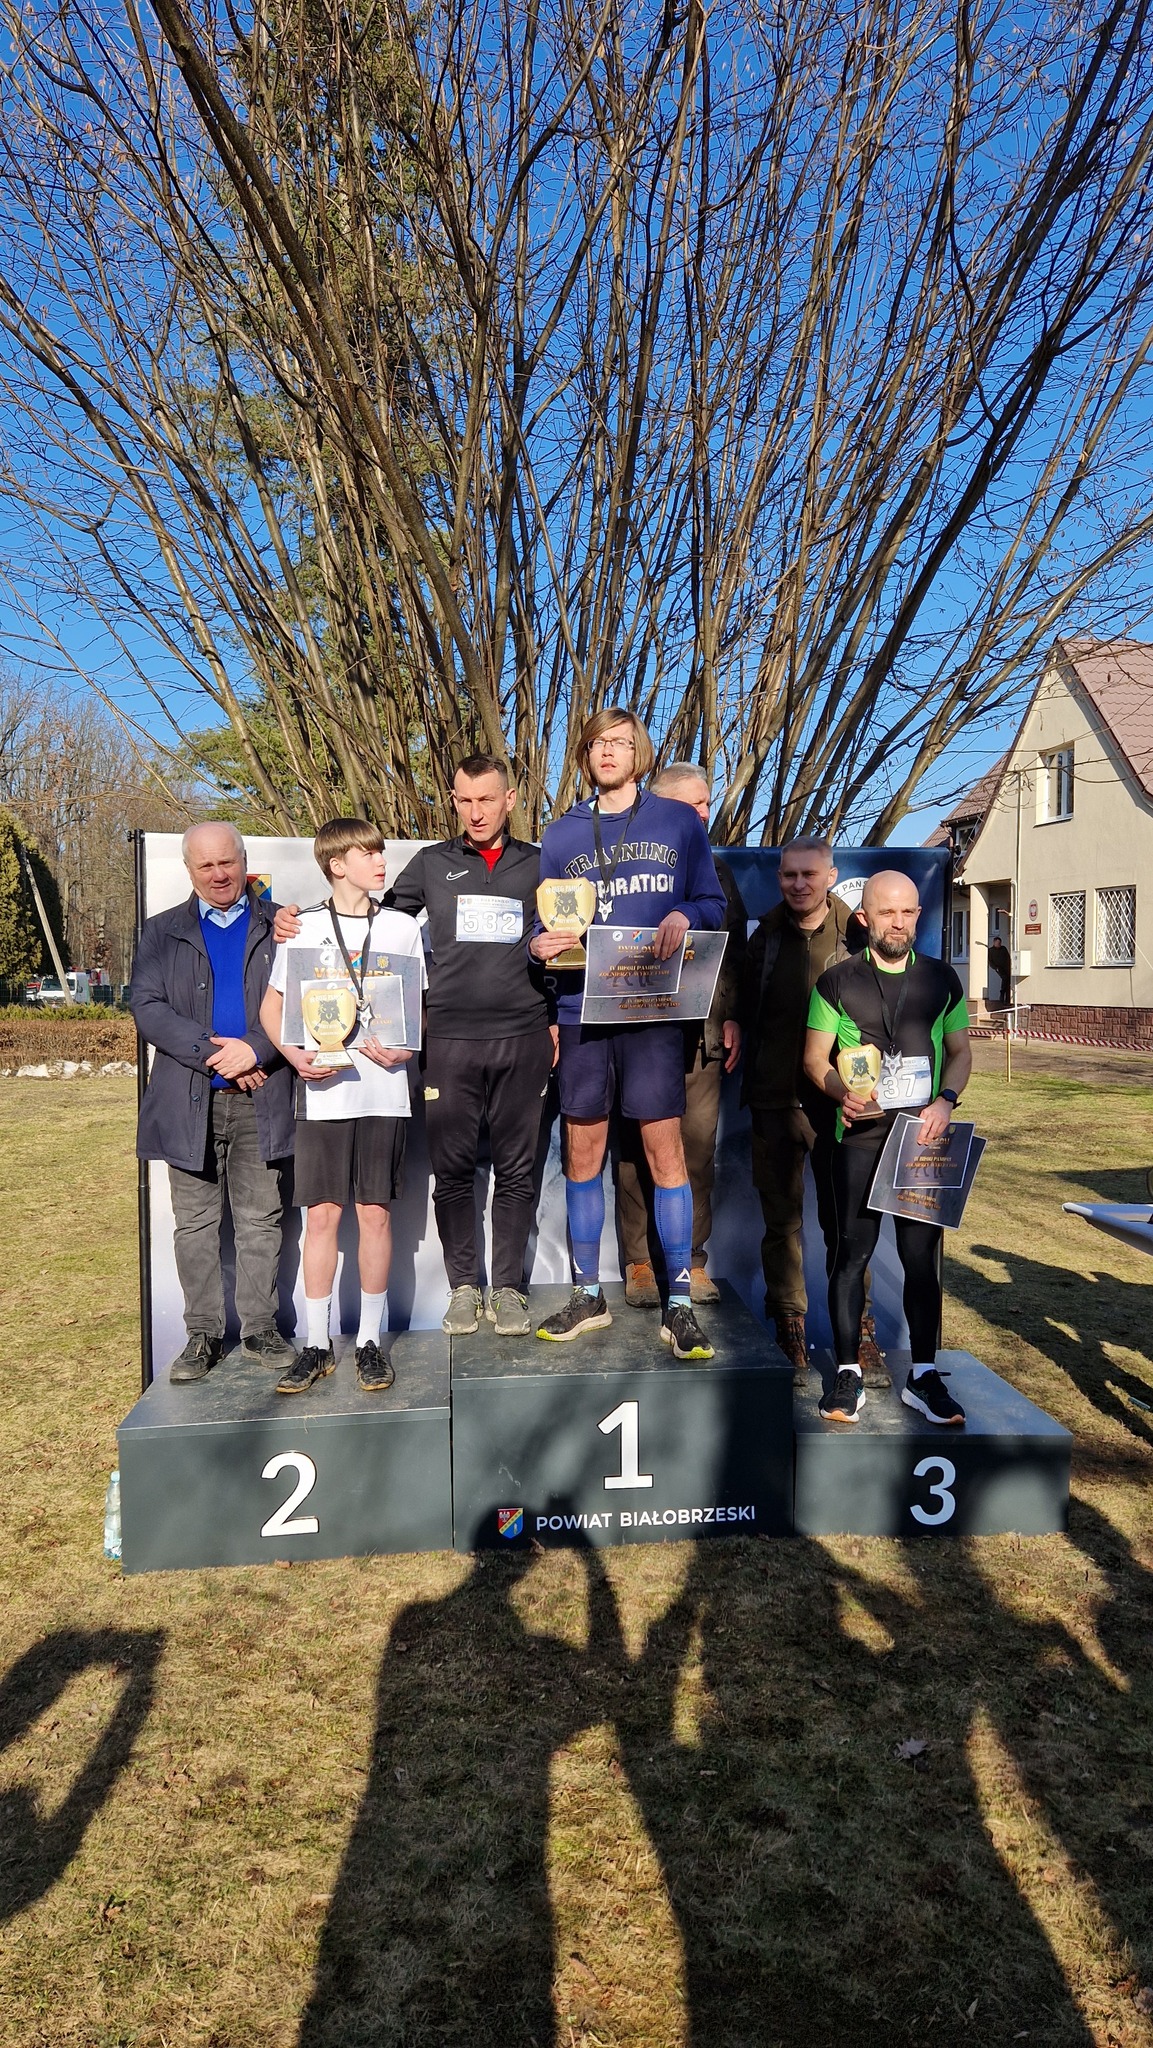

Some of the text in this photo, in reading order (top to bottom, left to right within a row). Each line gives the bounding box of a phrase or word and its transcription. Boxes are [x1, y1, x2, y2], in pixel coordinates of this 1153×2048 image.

[463, 909, 517, 935] 532
[882, 1073, 917, 1100] 37
[596, 1400, 654, 1490] 1
[260, 1451, 320, 1538] 2
[910, 1456, 956, 1526] 3
[535, 1505, 756, 1531] POWIAT BIAŁOBRZESKI
